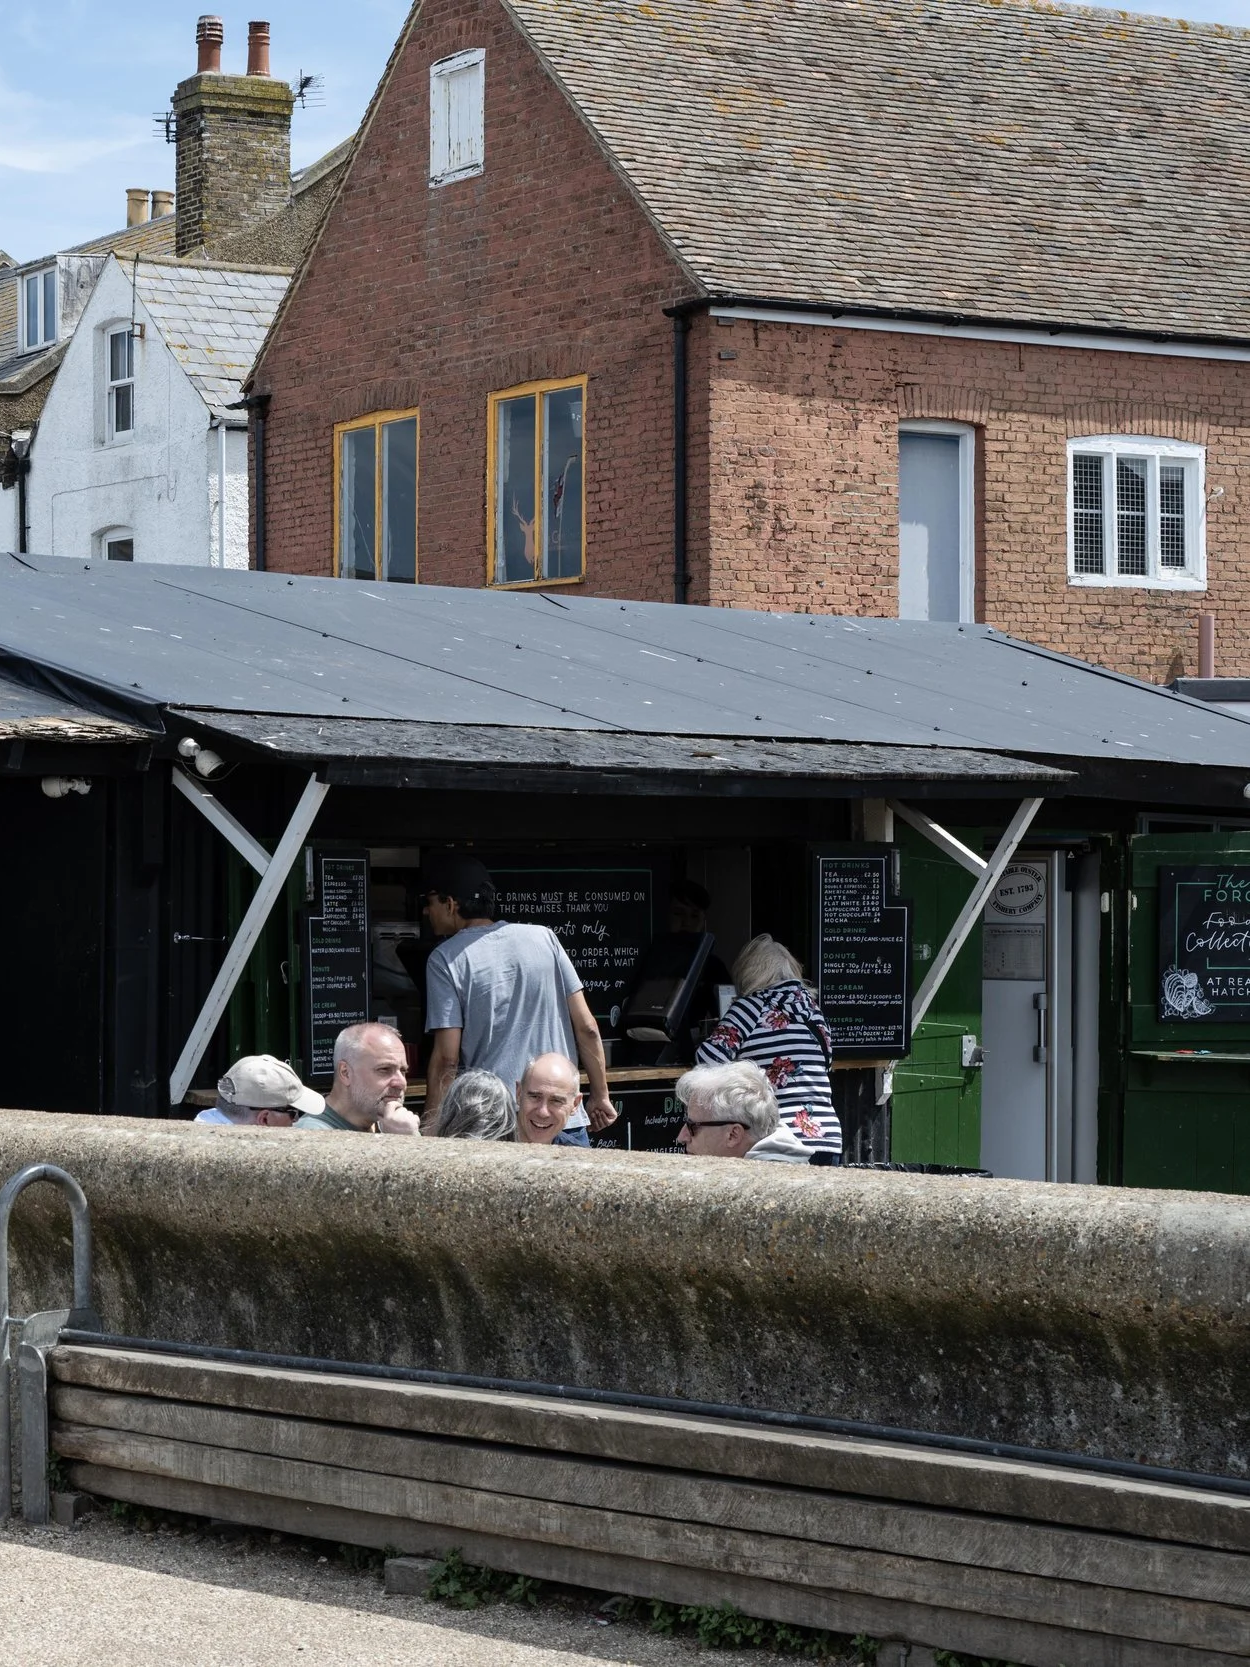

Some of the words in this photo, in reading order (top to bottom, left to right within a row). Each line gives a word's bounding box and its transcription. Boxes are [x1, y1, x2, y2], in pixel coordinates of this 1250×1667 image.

[1021, 866, 1042, 883] OYSTER
[1216, 873, 1250, 889] The
[506, 892, 537, 902] DRINKS
[541, 892, 563, 903] MUST
[568, 892, 579, 902] BE
[584, 891, 631, 902] CONSUMED
[634, 892, 645, 902] ON
[999, 887, 1015, 897] EST.
[1017, 884, 1034, 894] 1793
[499, 904, 516, 914] THE
[566, 903, 591, 913] THANK
[592, 902, 609, 912] YOU
[992, 901, 1017, 915] FISHERY
[1019, 893, 1043, 914] COMPANY
[582, 919, 610, 942] only
[1185, 931, 1250, 952] Collect
[614, 948, 639, 956] WHICH
[572, 959, 598, 968] UNTER
[604, 959, 610, 967] A
[614, 958, 635, 967] WAIT
[1206, 977, 1222, 986] AT
